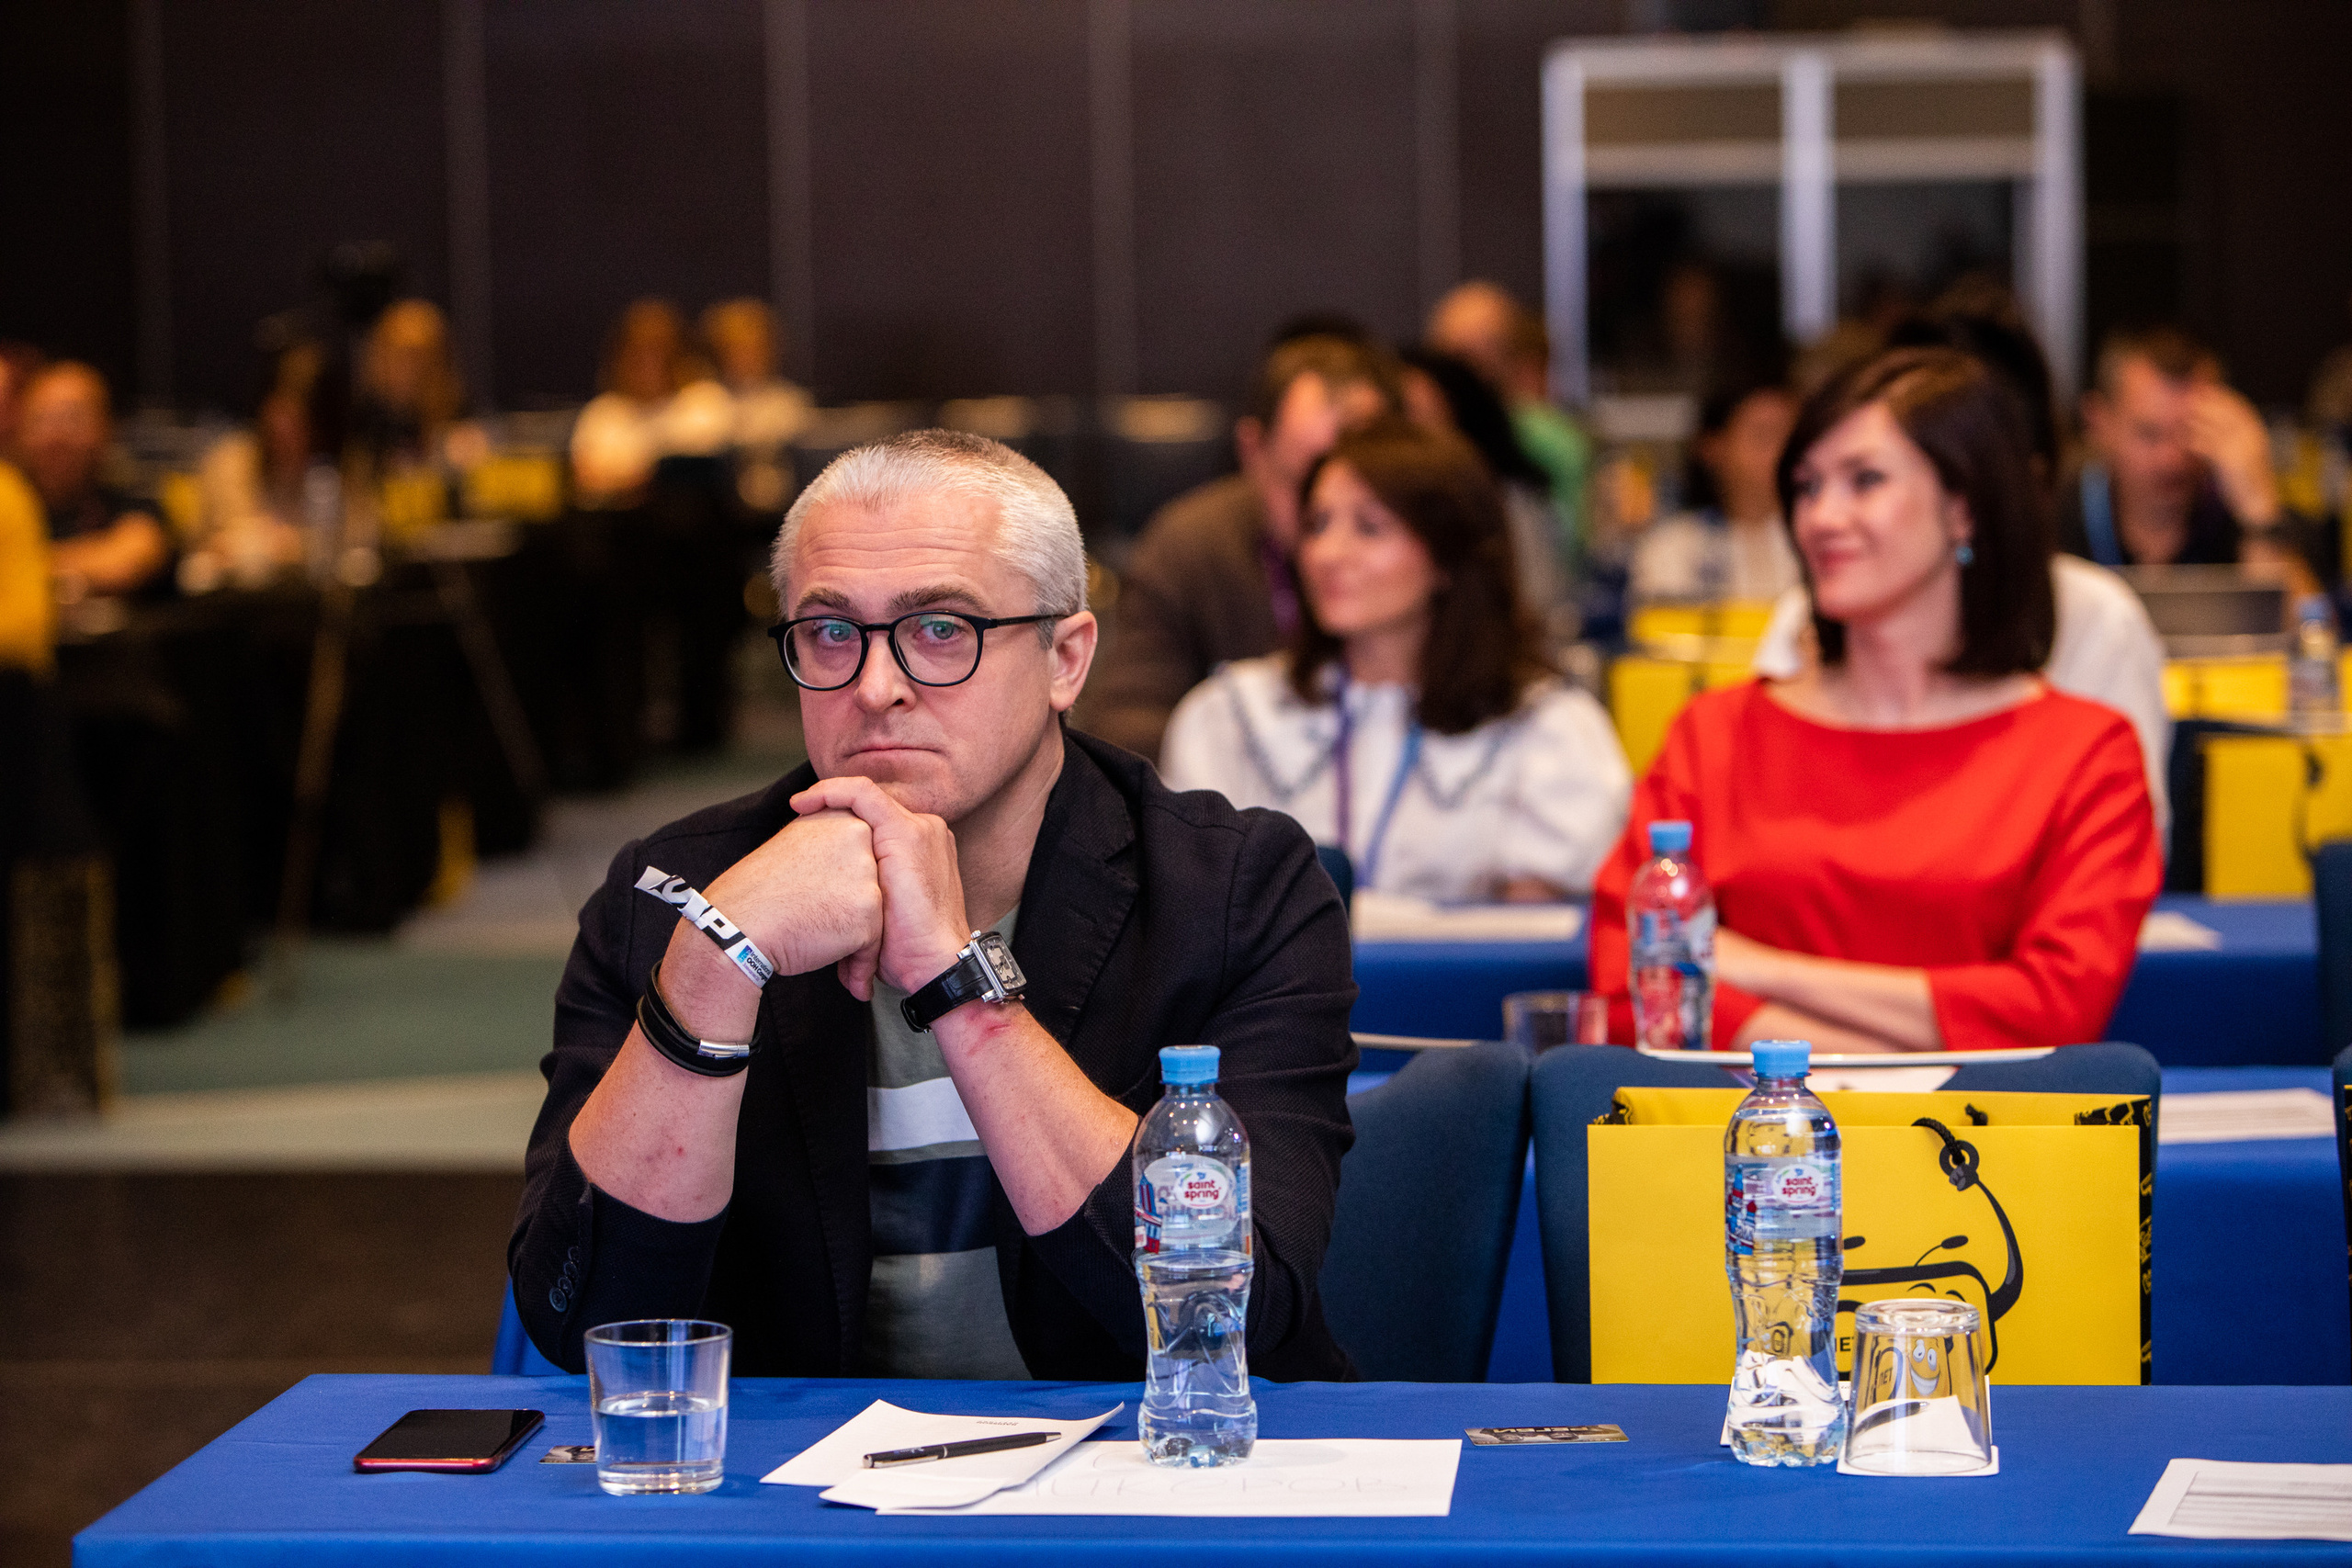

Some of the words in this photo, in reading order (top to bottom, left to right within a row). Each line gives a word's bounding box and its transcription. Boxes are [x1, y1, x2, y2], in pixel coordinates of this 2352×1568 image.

[746, 957, 758, 971] OOH
[1188, 1179, 1216, 1190] saint
[1786, 1176, 1813, 1186] saint
[1184, 1190, 1219, 1201] spring
[1782, 1187, 1816, 1198] spring
